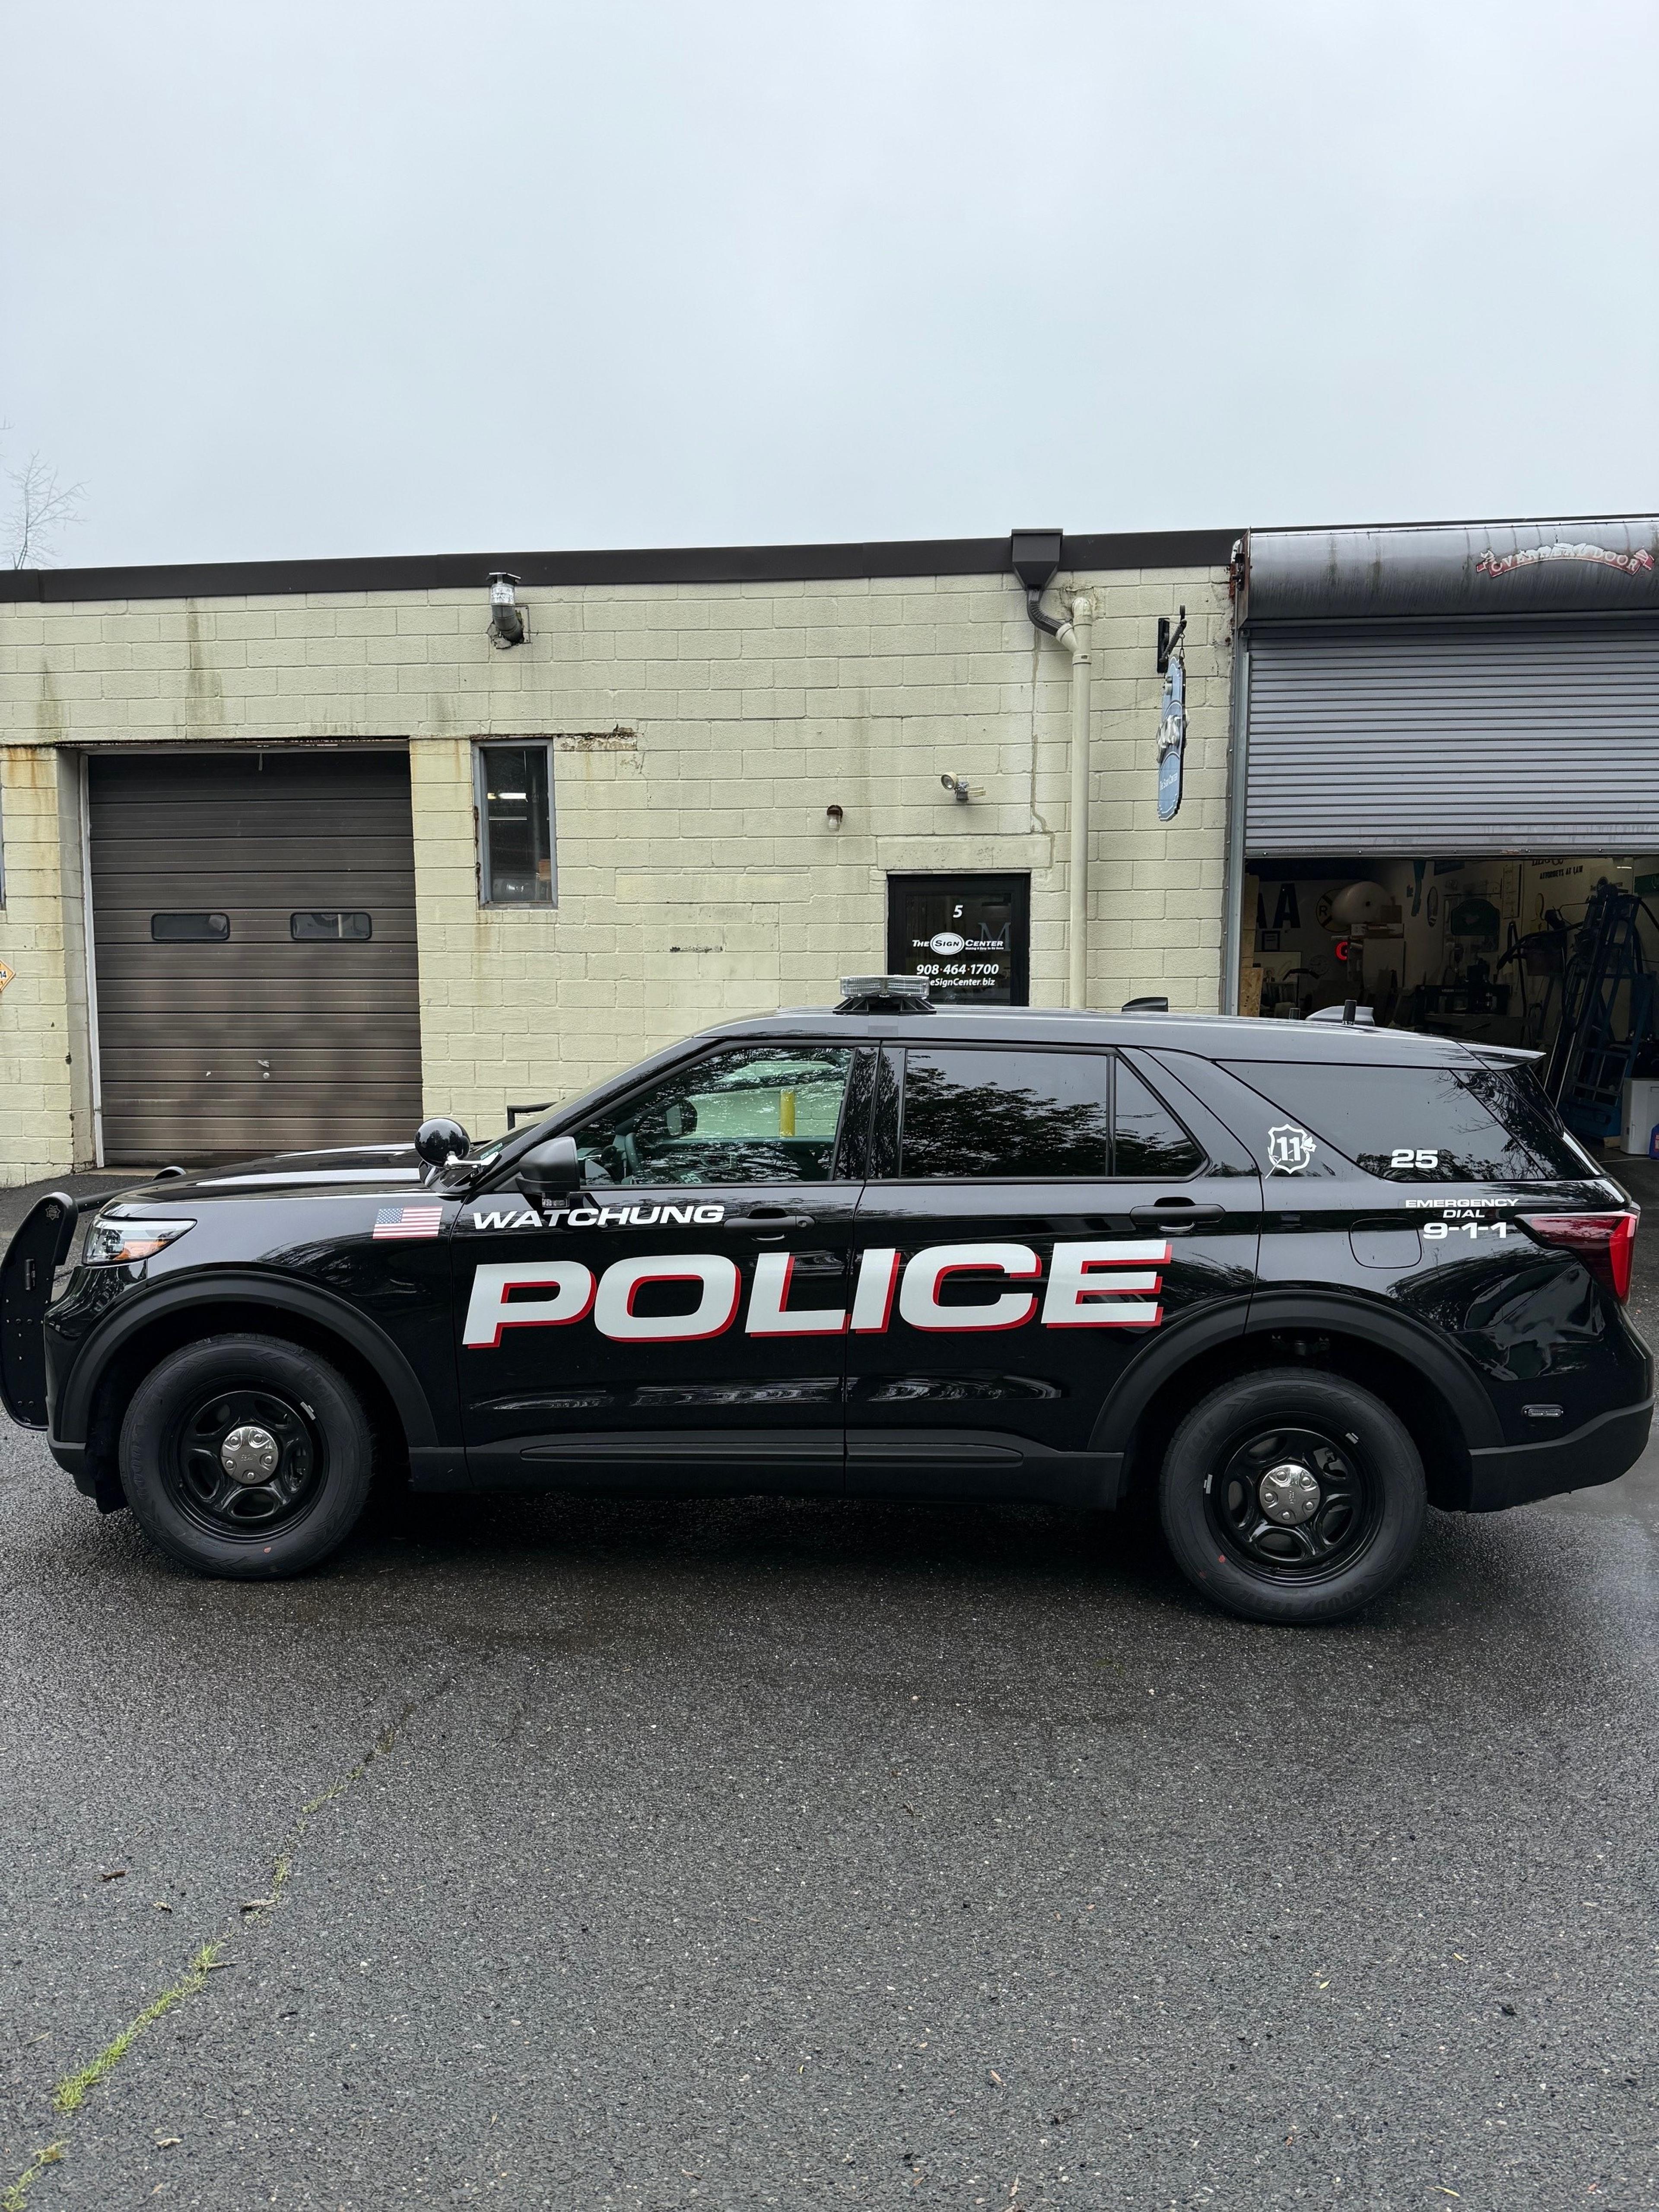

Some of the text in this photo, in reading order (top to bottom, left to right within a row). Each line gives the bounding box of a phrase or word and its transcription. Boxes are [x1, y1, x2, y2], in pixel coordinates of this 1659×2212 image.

[1593, 544, 1637, 572] DOOR
[953, 905, 963, 918] 5
[1276, 1136, 1301, 1161] 11
[1391, 1149, 1438, 1169] 25
[1405, 1198, 1519, 1208] EMERGENCY
[473, 1205, 725, 1230] WATCHUNG
[1443, 1209, 1485, 1218] DIAL
[1423, 1222, 1506, 1239] 9-1-1
[462, 1239, 1172, 1349] POLICE
